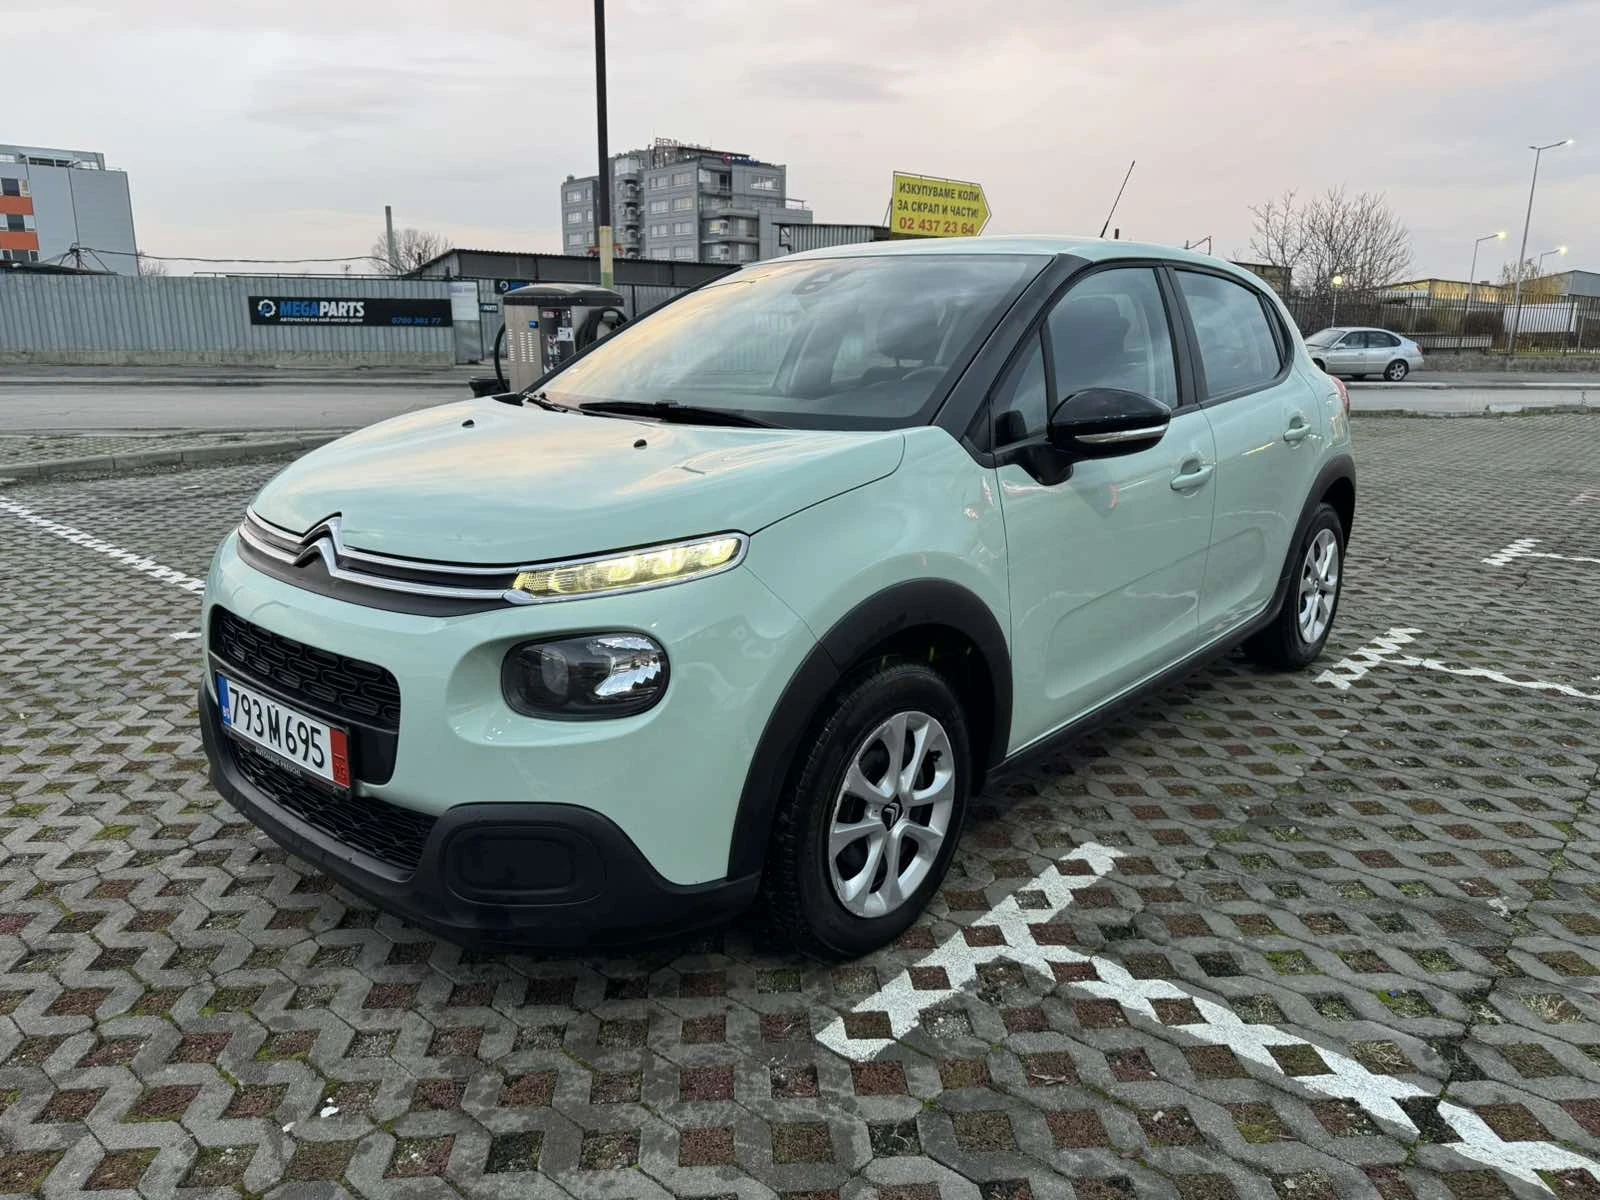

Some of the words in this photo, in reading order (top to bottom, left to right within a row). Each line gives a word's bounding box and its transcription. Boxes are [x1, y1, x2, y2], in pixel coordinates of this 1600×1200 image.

[900, 183, 956, 198] ИЗКУПУВАМЕ
[957, 190, 979, 202] КОЛИ
[898, 199, 909, 211] ЗА
[911, 201, 940, 214] СКРАП
[942, 205, 948, 216] И
[900, 217, 914, 230] 02
[919, 219, 940, 232] 437
[944, 221, 957, 233] 23
[961, 223, 975, 235] 64
[280, 301, 365, 317] MEGAPARTS
